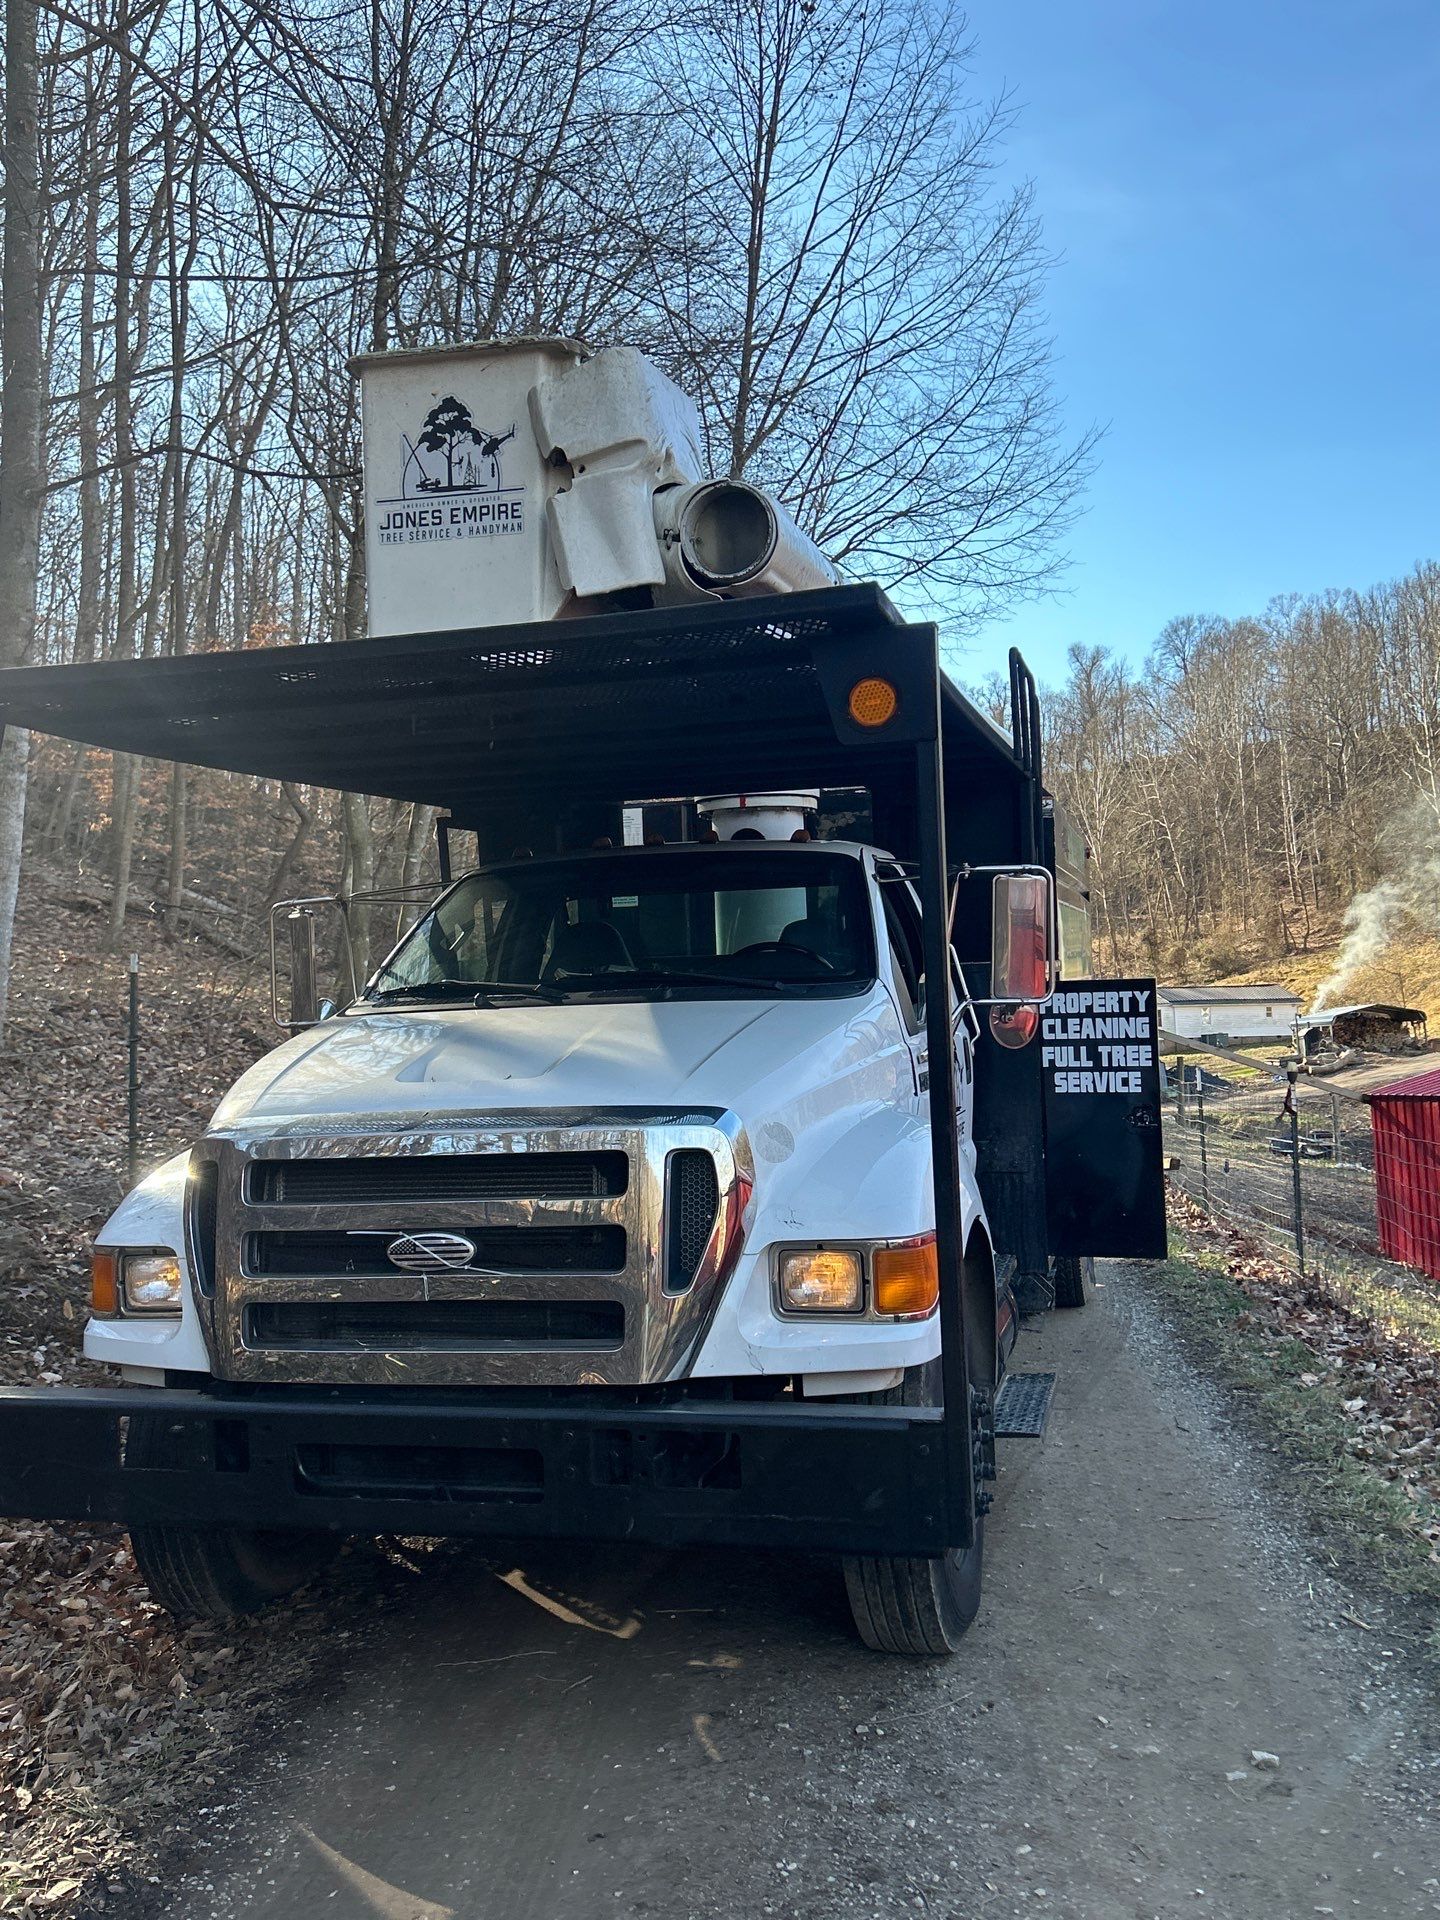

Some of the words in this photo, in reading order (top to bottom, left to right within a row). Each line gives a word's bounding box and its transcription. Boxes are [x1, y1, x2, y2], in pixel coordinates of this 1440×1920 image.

[380, 509, 442, 530] JONES
[450, 502, 522, 524] EMPIRE
[380, 531, 404, 543] TREE
[409, 528, 450, 541] SERVICE
[456, 529, 462, 537] &
[469, 522, 523, 536] HANDYMAN
[1040, 990, 1150, 1014] PROPERTY
[1042, 1017, 1150, 1040] CLEANING
[1042, 1046, 1093, 1067] FULL
[1098, 1045, 1152, 1067] TREE
[1054, 1071, 1142, 1093] SERVICE
